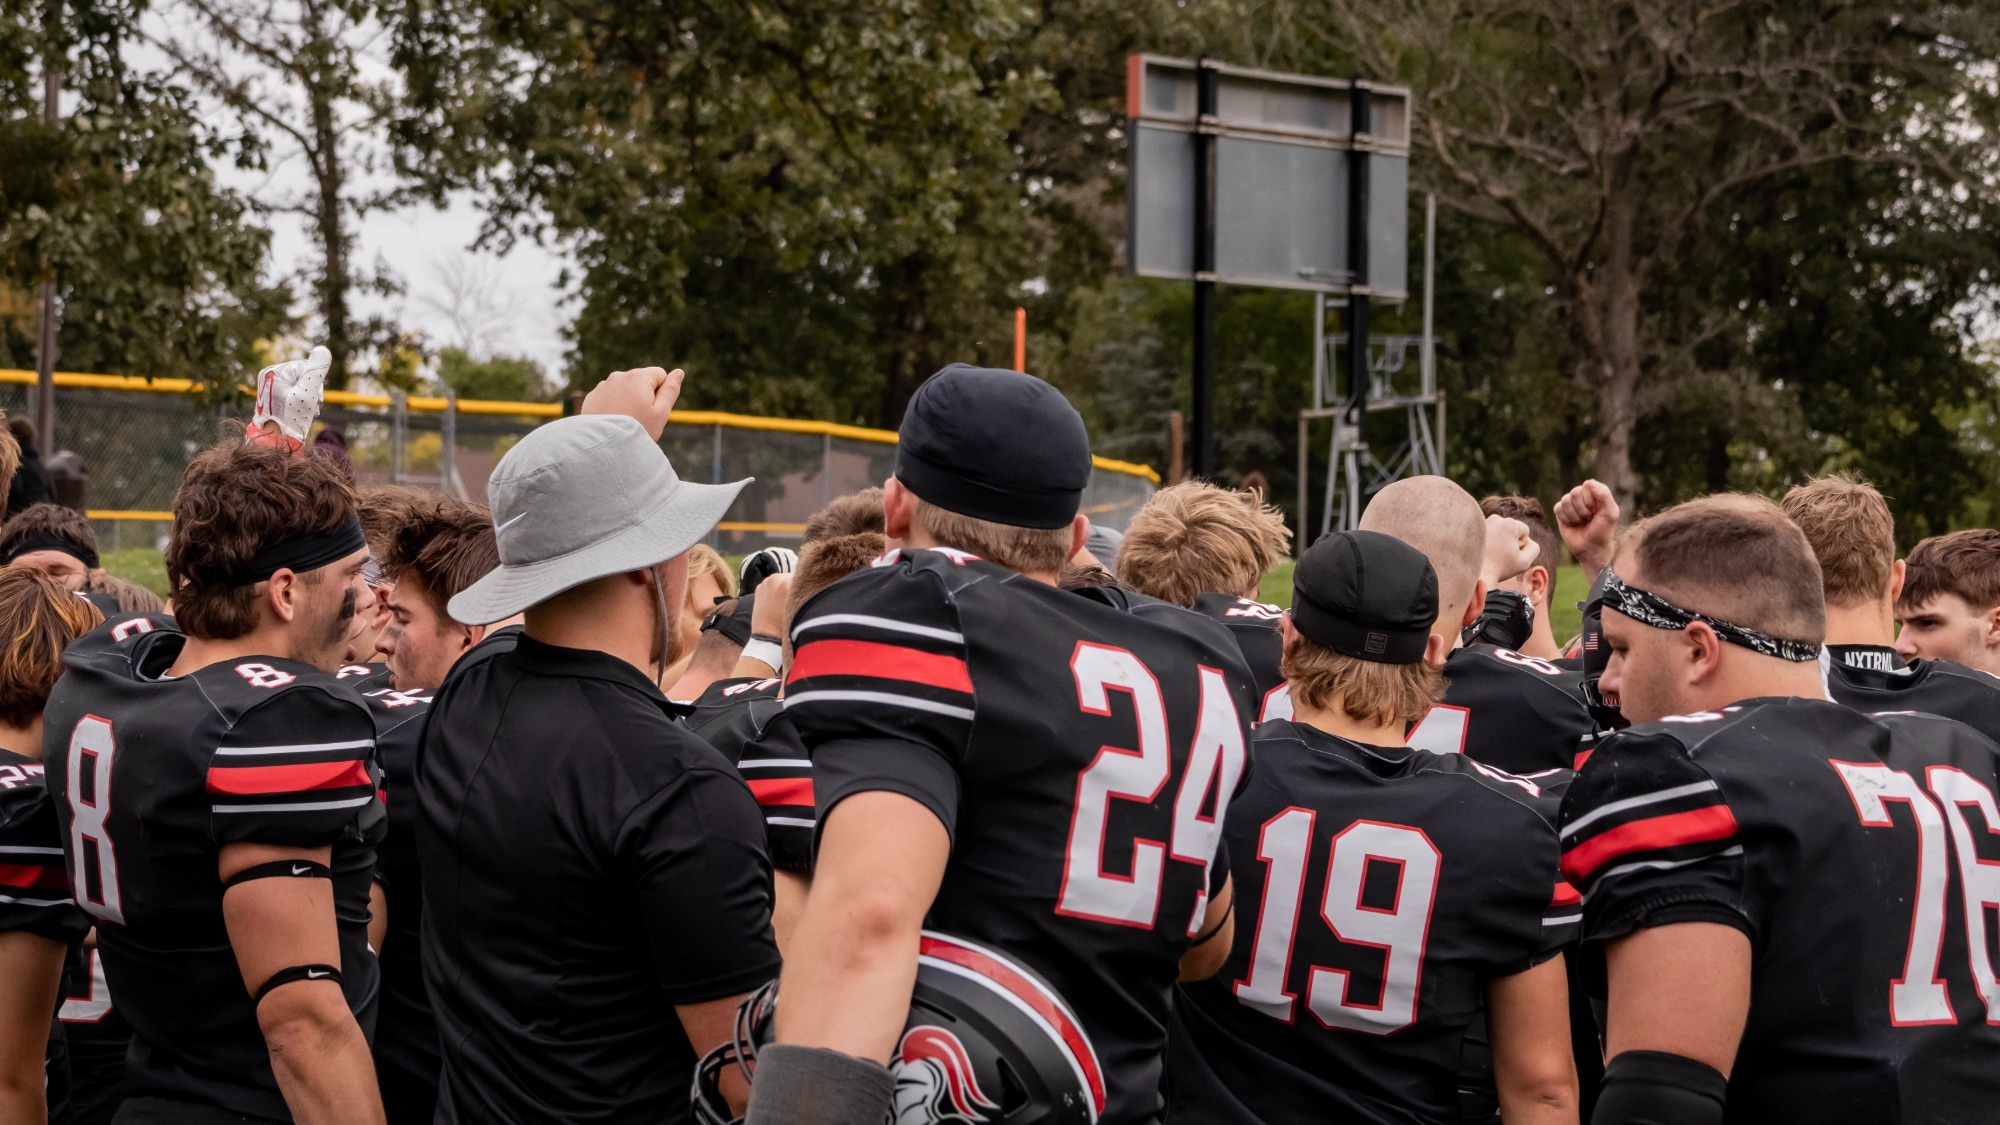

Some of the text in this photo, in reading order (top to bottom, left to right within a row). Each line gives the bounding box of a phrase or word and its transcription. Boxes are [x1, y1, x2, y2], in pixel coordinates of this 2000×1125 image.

[234, 662, 297, 689] 8
[1055, 640, 1247, 937] 24
[66, 713, 127, 927] 8
[1233, 806, 1443, 1037] 19
[1828, 758, 2000, 1027] 76
